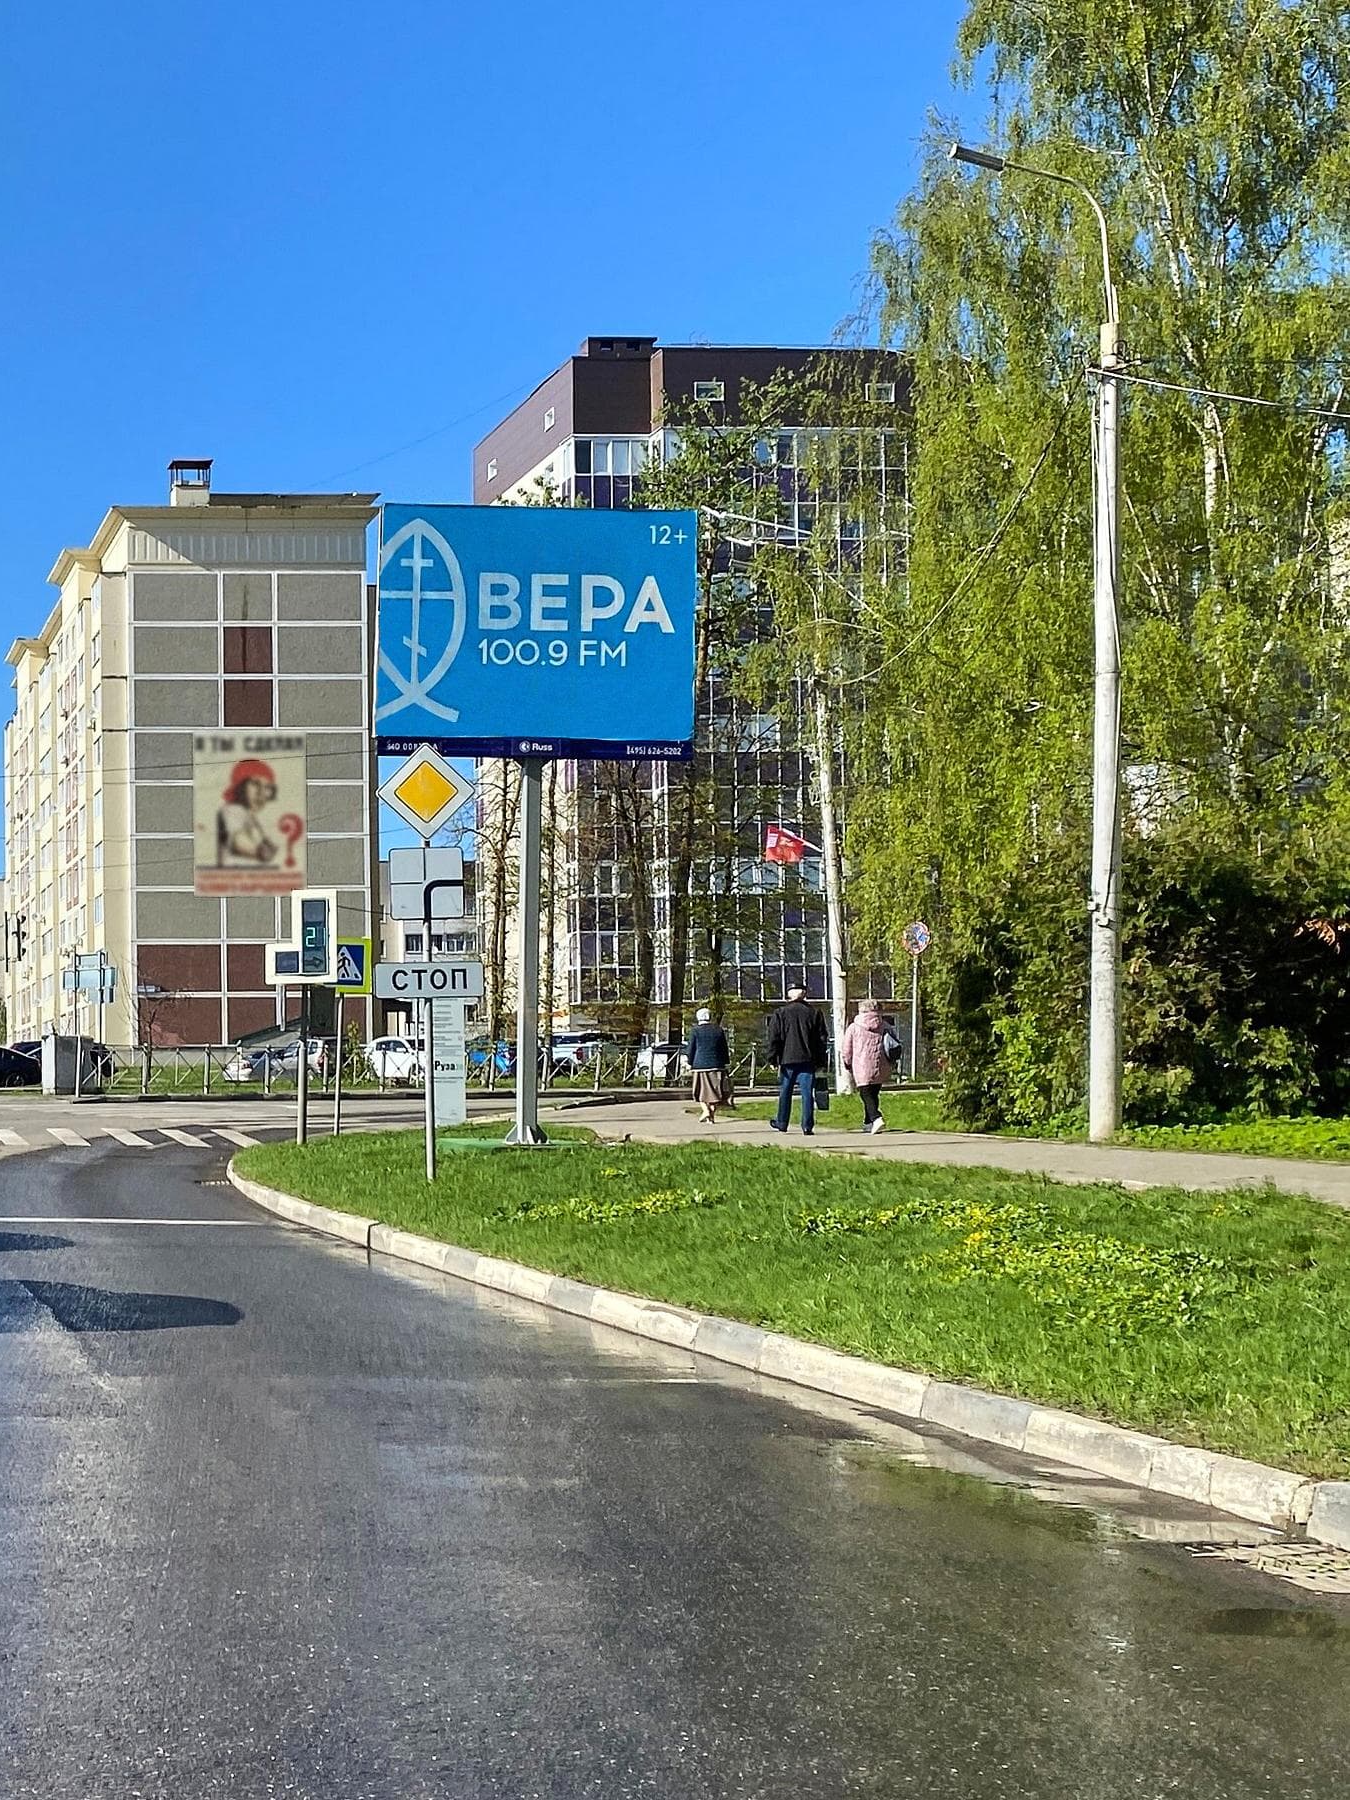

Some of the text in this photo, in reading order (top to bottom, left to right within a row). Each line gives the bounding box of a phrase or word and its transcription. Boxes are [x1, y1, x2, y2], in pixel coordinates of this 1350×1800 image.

[650, 525, 688, 545] 12+
[478, 572, 675, 634] ВЕРА
[478, 638, 627, 667] 100.9 FM
[531, 742, 553, 751] Russ
[391, 968, 468, 991] СТОП
